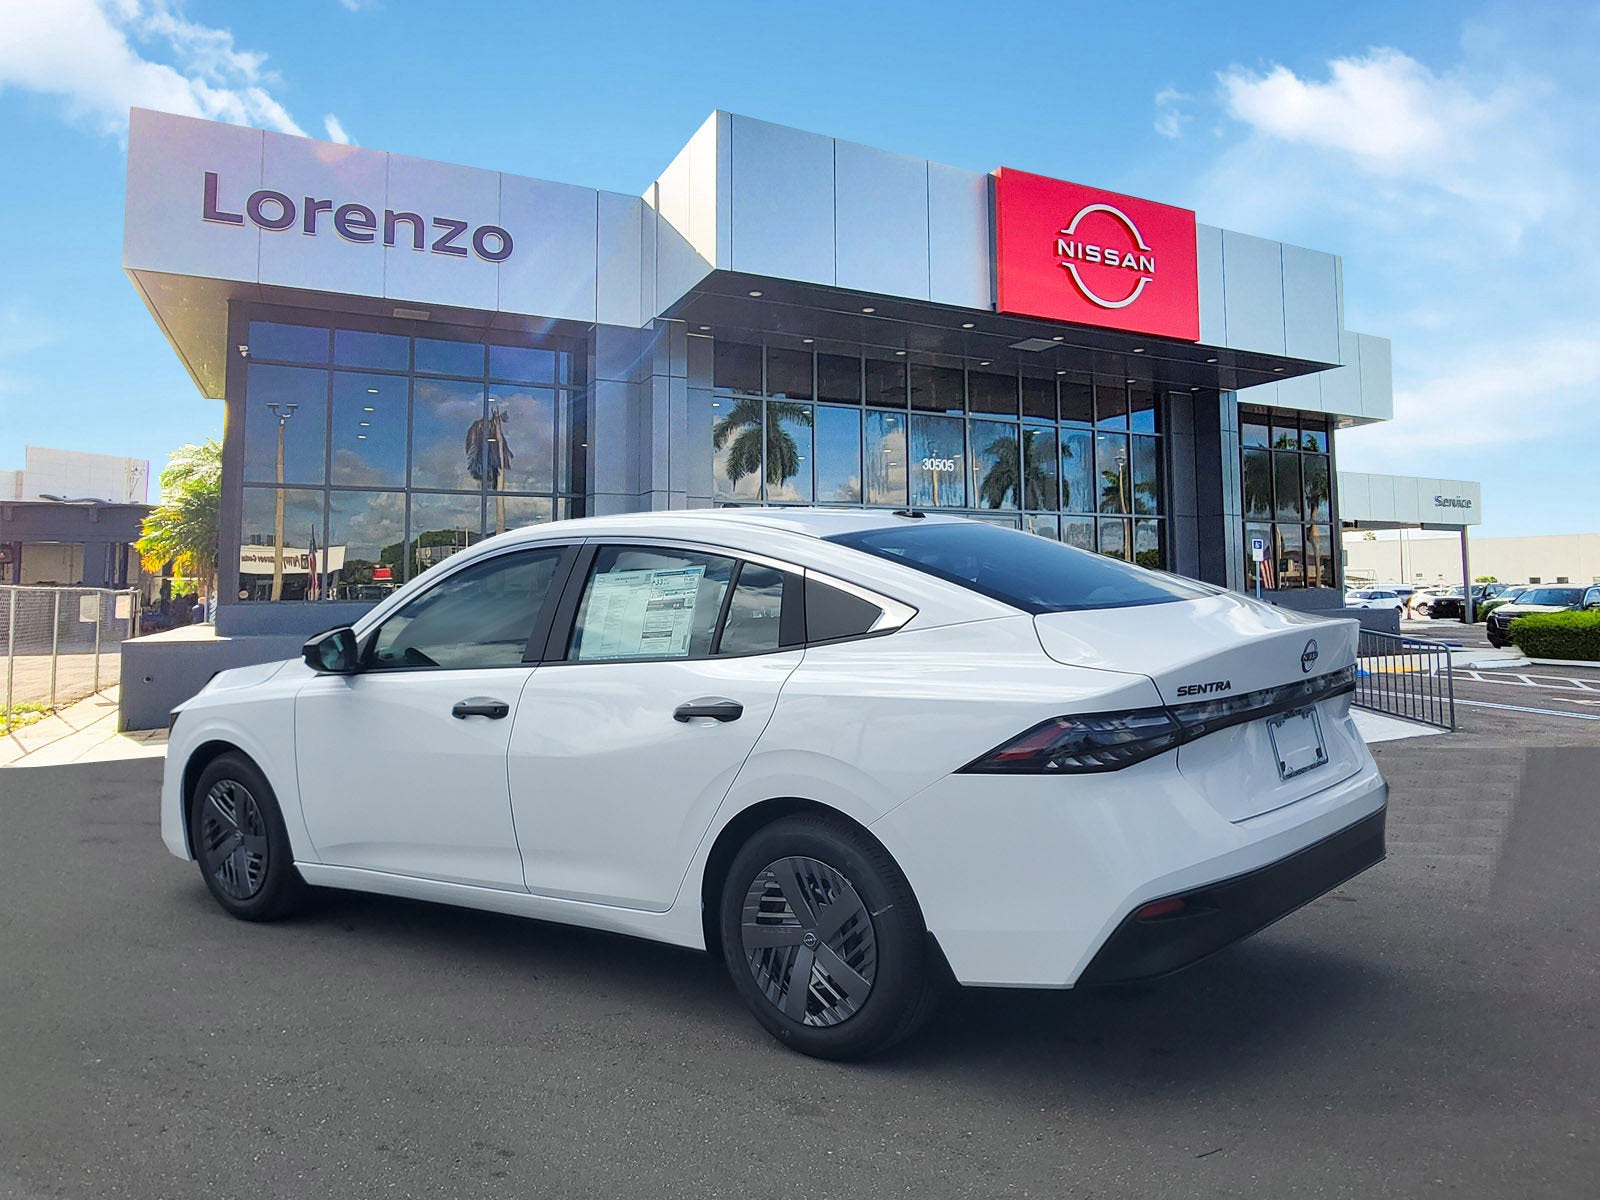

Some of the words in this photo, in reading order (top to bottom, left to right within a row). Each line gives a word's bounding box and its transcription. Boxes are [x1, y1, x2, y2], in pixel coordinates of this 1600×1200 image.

[203, 171, 514, 262] Lorenzo
[1057, 238, 1155, 273] NISSAN
[922, 458, 954, 471] 30505
[1434, 495, 1472, 508] Service
[1177, 680, 1231, 696] SENTRA
